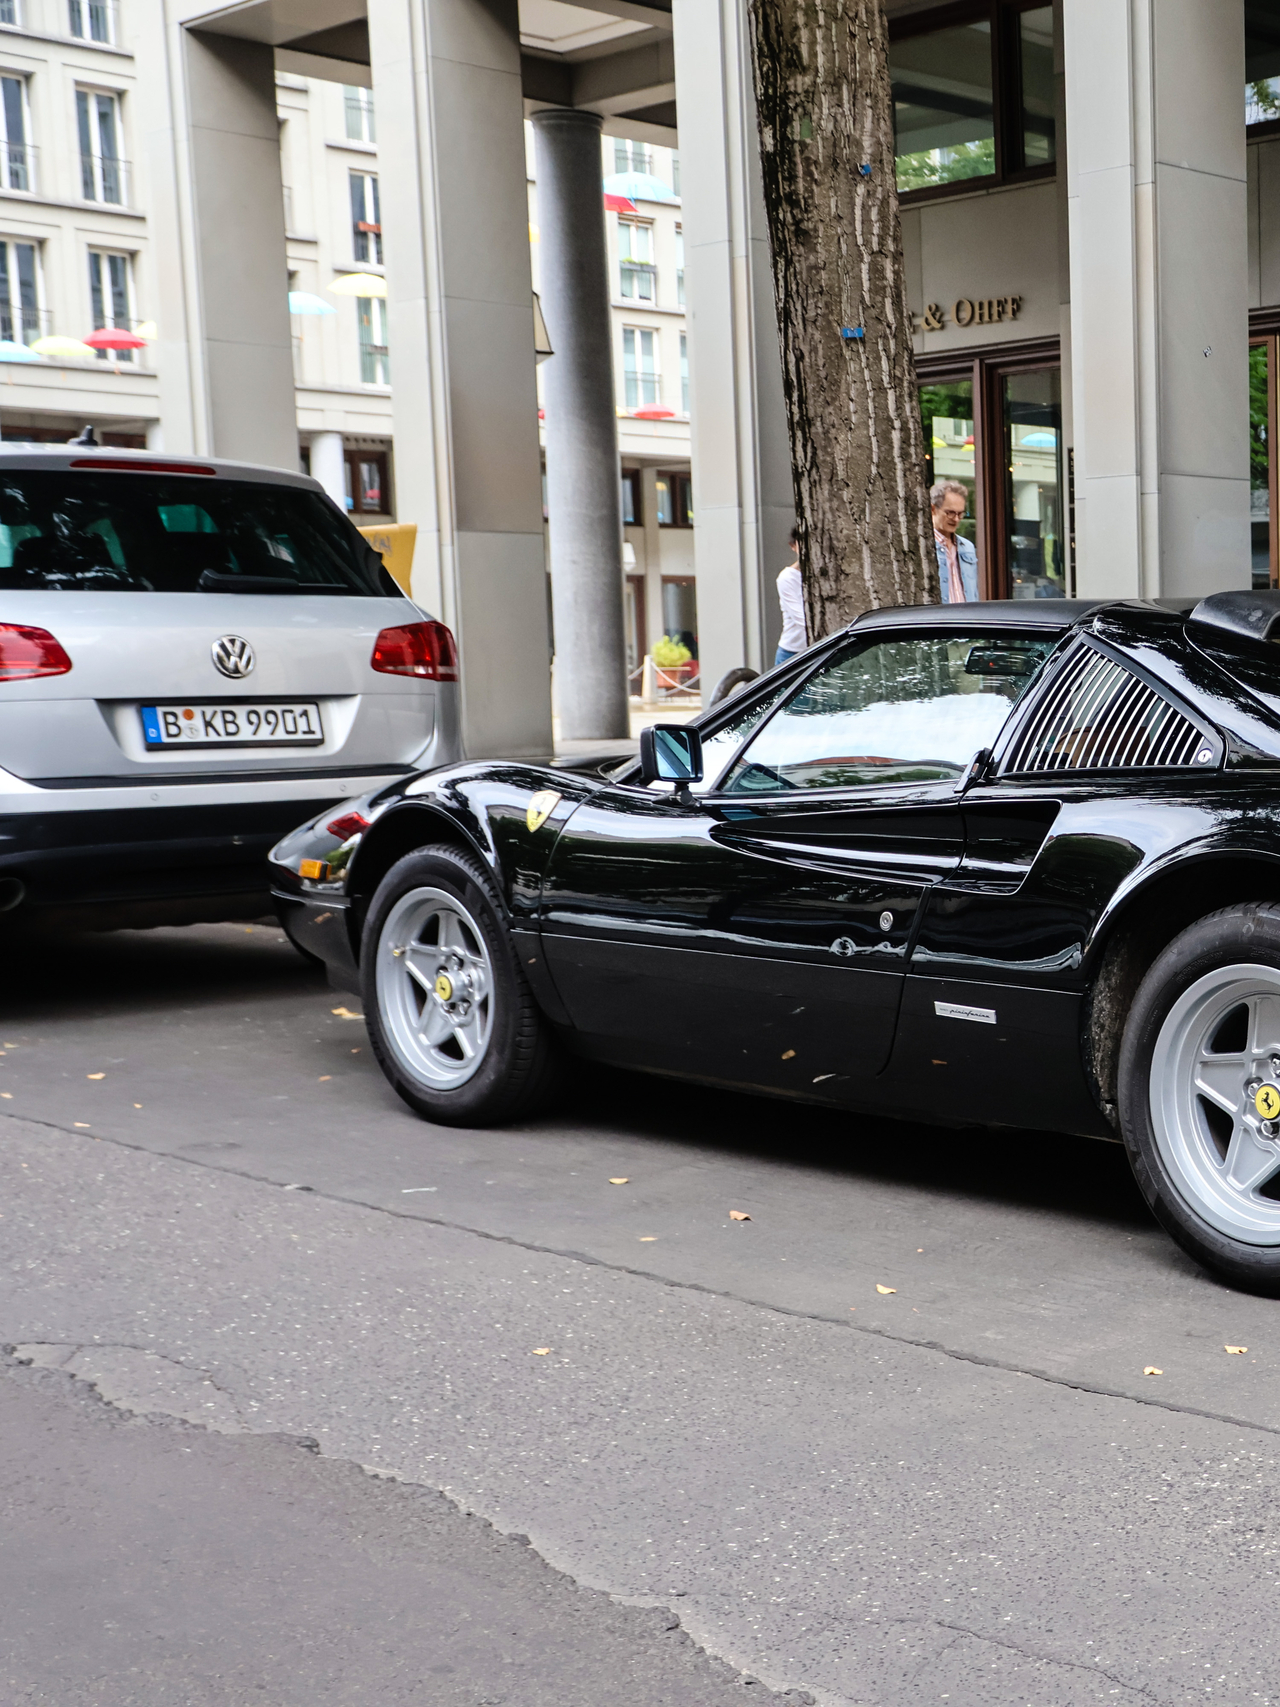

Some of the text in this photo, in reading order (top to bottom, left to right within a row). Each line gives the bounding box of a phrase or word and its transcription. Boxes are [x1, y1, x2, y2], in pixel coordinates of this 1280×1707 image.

[921, 302, 945, 331] &
[202, 709, 240, 738] KB
[246, 708, 316, 737] 9901
